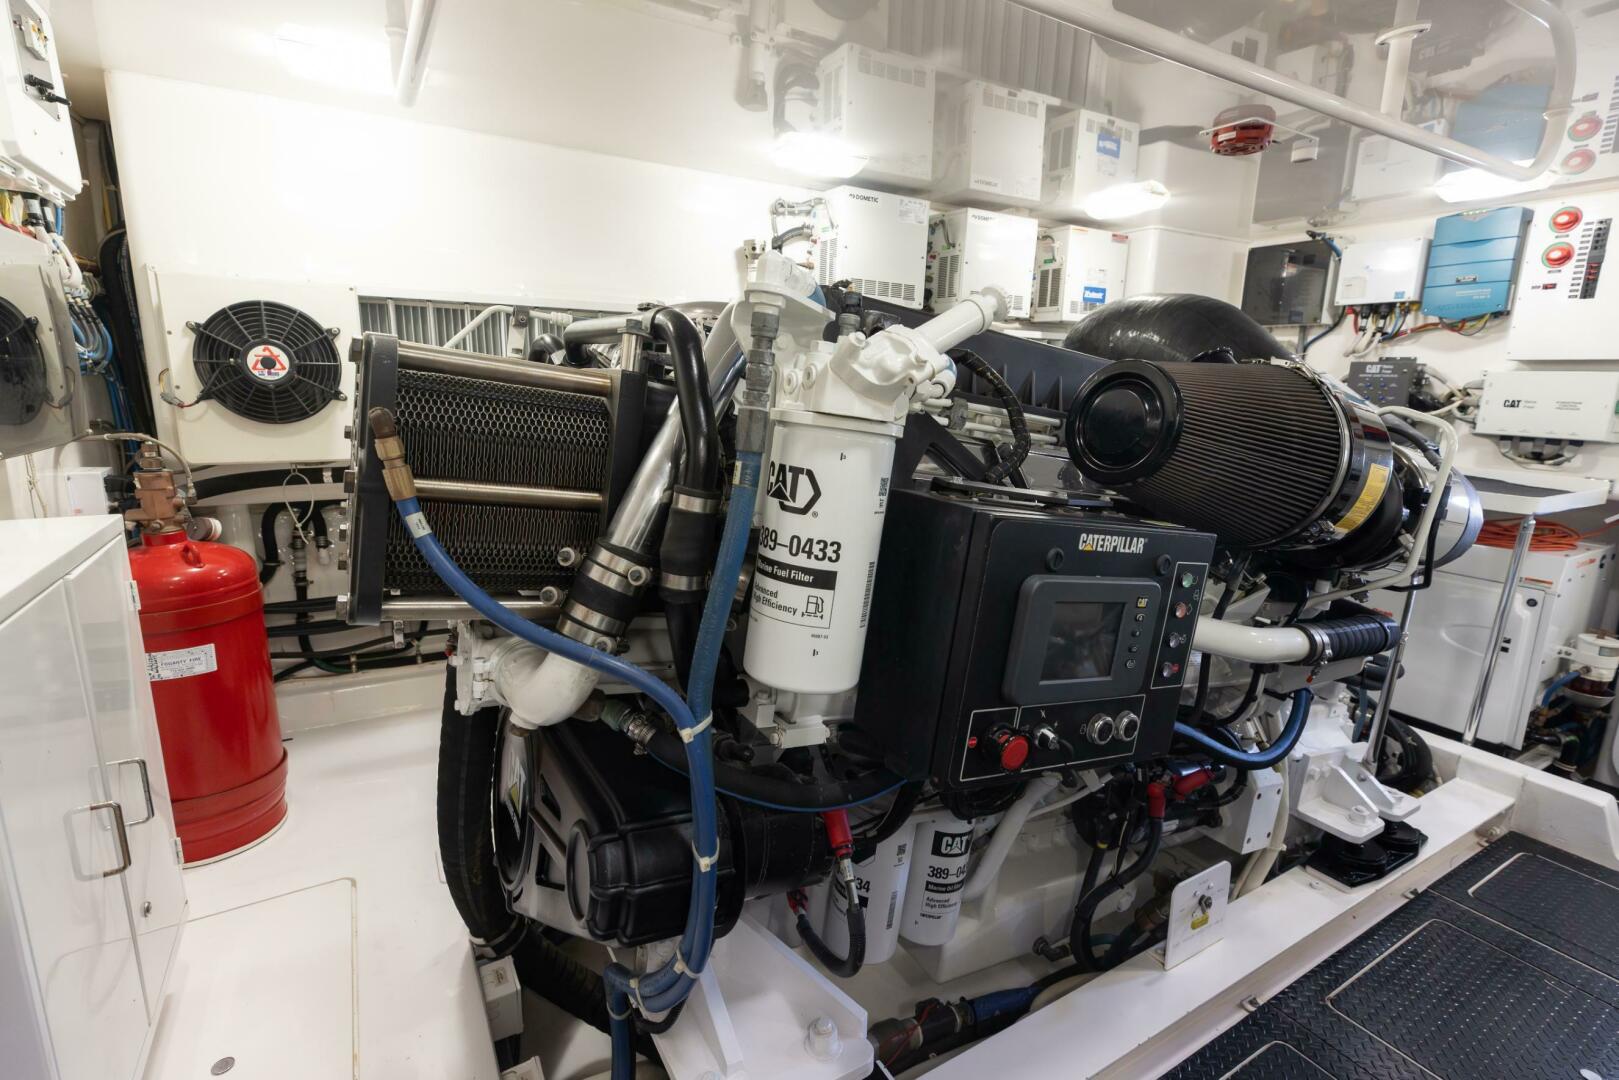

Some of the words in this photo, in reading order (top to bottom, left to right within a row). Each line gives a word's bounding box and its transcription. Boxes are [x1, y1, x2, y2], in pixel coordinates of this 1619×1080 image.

[1503, 399, 1522, 408] CAT
[766, 460, 805, 503] CAT
[1078, 533, 1145, 554] CATERPILLAR
[773, 564, 790, 579] Fuel
[790, 569, 815, 583] Filter
[761, 595, 798, 616] Efficiency
[940, 836, 968, 855] CAT
